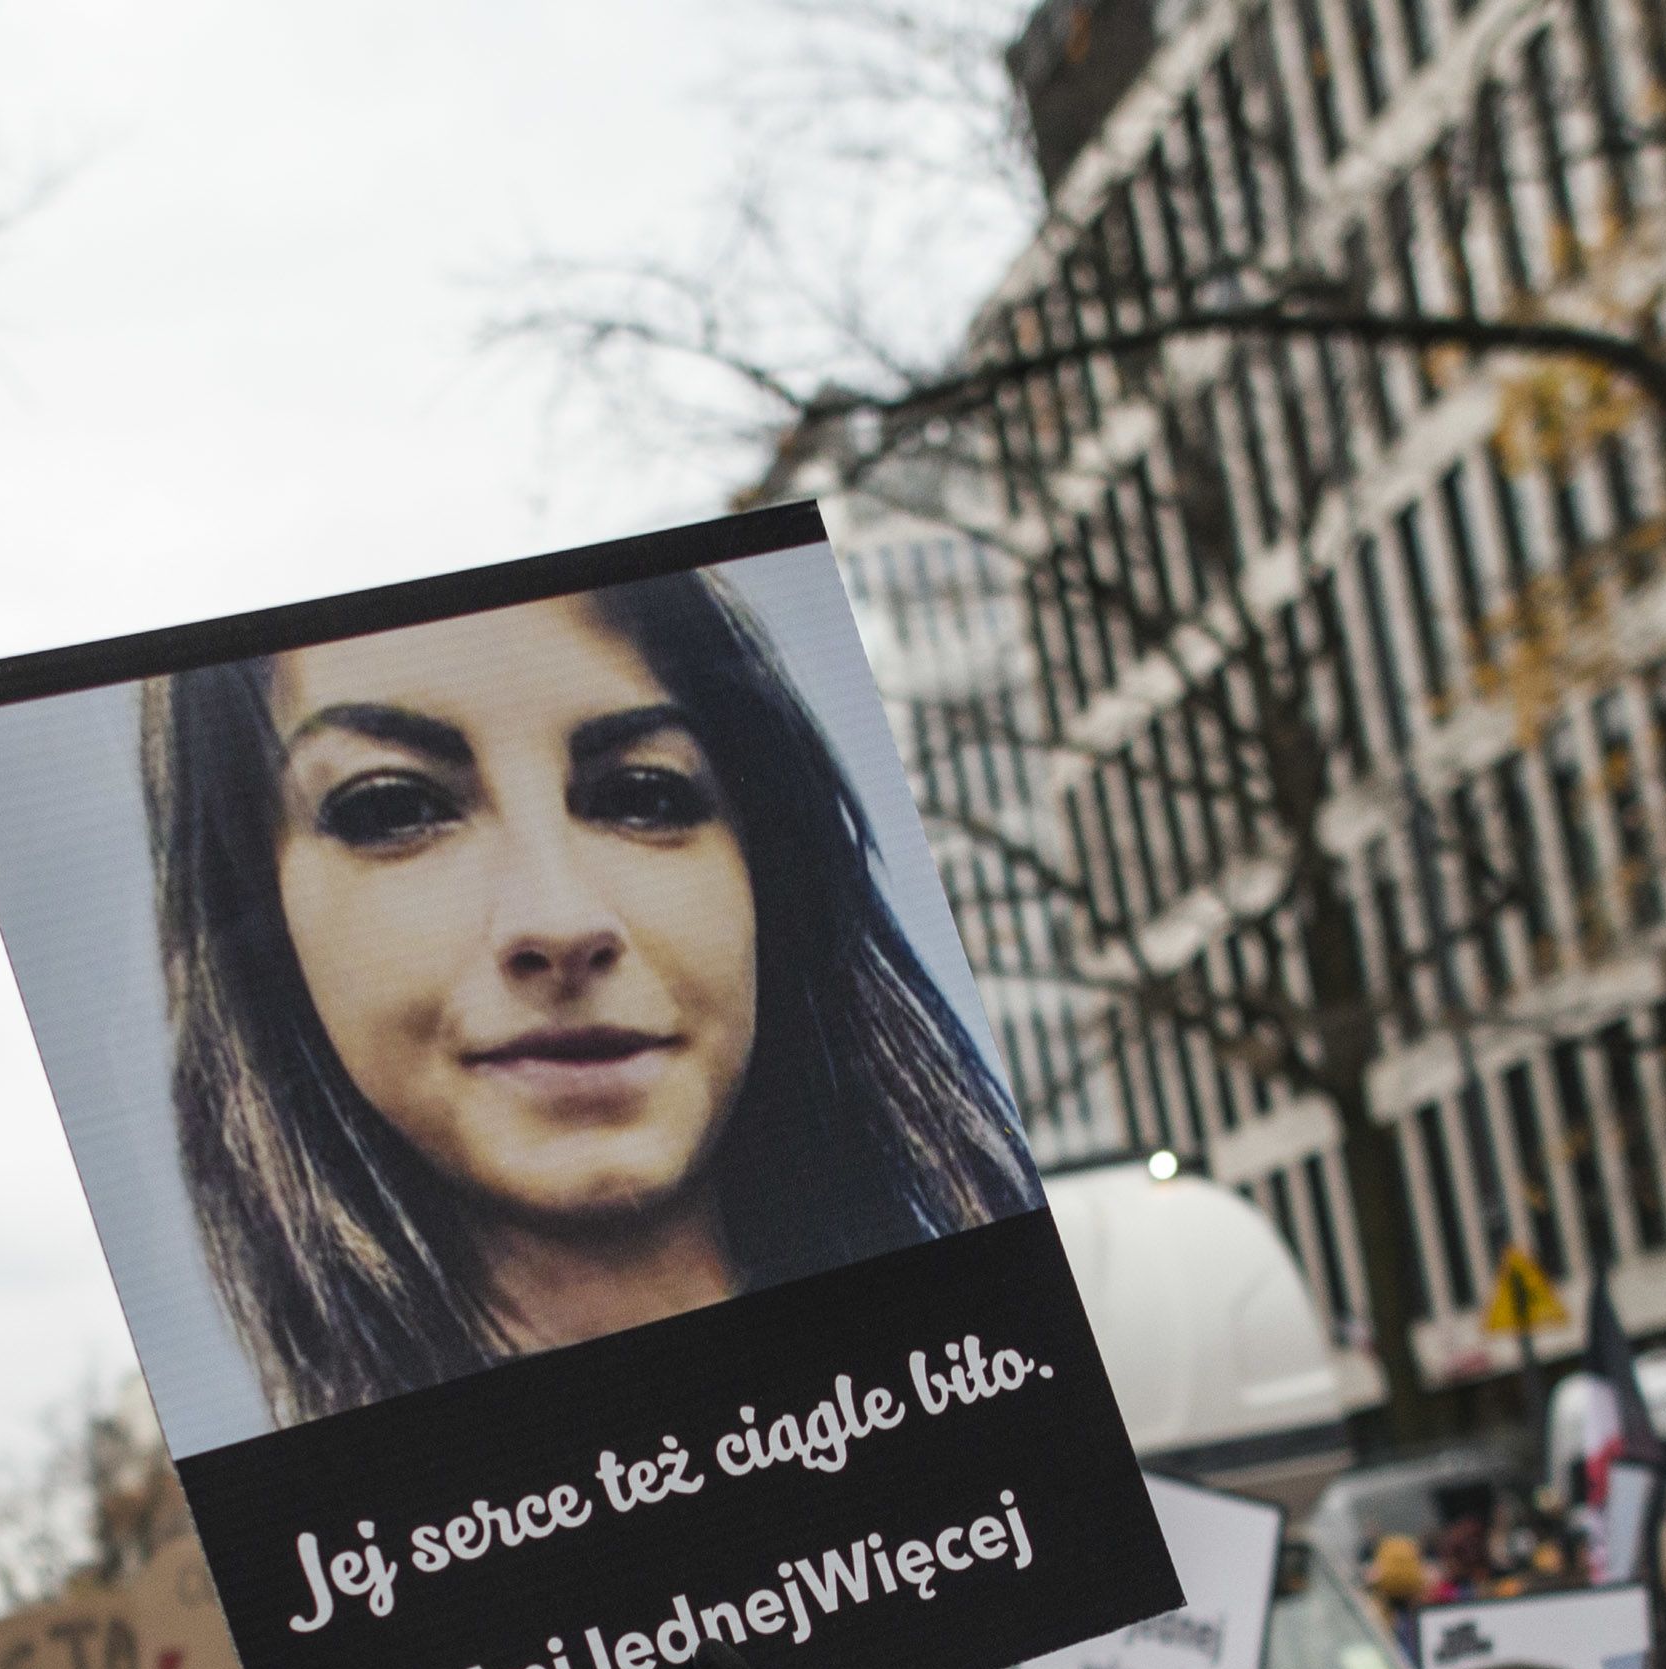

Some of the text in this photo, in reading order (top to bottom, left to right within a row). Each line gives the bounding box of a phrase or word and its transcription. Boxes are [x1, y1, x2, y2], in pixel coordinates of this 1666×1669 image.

[289, 1520, 398, 1634] Jej
[411, 1481, 594, 1572] serce
[595, 1435, 705, 1515] też
[716, 1374, 905, 1476] ciągle
[908, 1333, 1055, 1416] biło.
